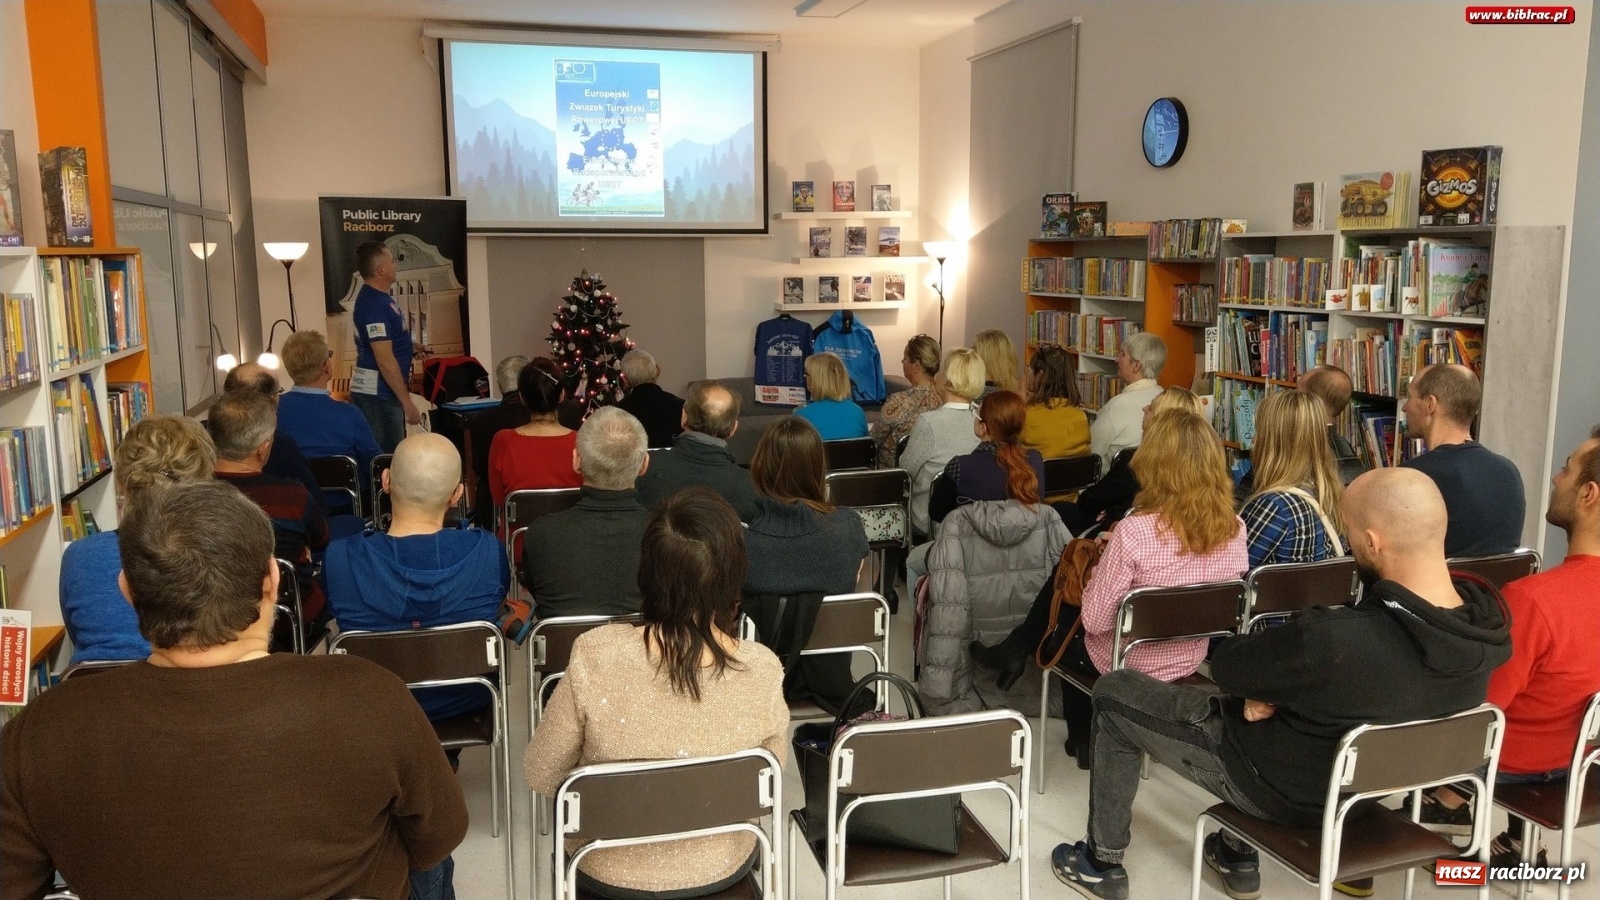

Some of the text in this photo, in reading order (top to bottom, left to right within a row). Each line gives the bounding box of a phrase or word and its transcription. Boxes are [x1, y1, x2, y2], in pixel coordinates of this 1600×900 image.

[584, 89, 630, 99] Europejski
[569, 103, 645, 113] Związek Turystyki
[571, 115, 644, 124] Rowerowej UECT
[1045, 196, 1070, 204] ORBIS
[342, 209, 422, 223] Public Library
[343, 221, 395, 232] Raciborz
[1440, 252, 1462, 261] Konie
[3, 636, 12, 669] historie
[13, 630, 25, 698] Wojny dorosłych
[1, 670, 10, 695] dzieci
